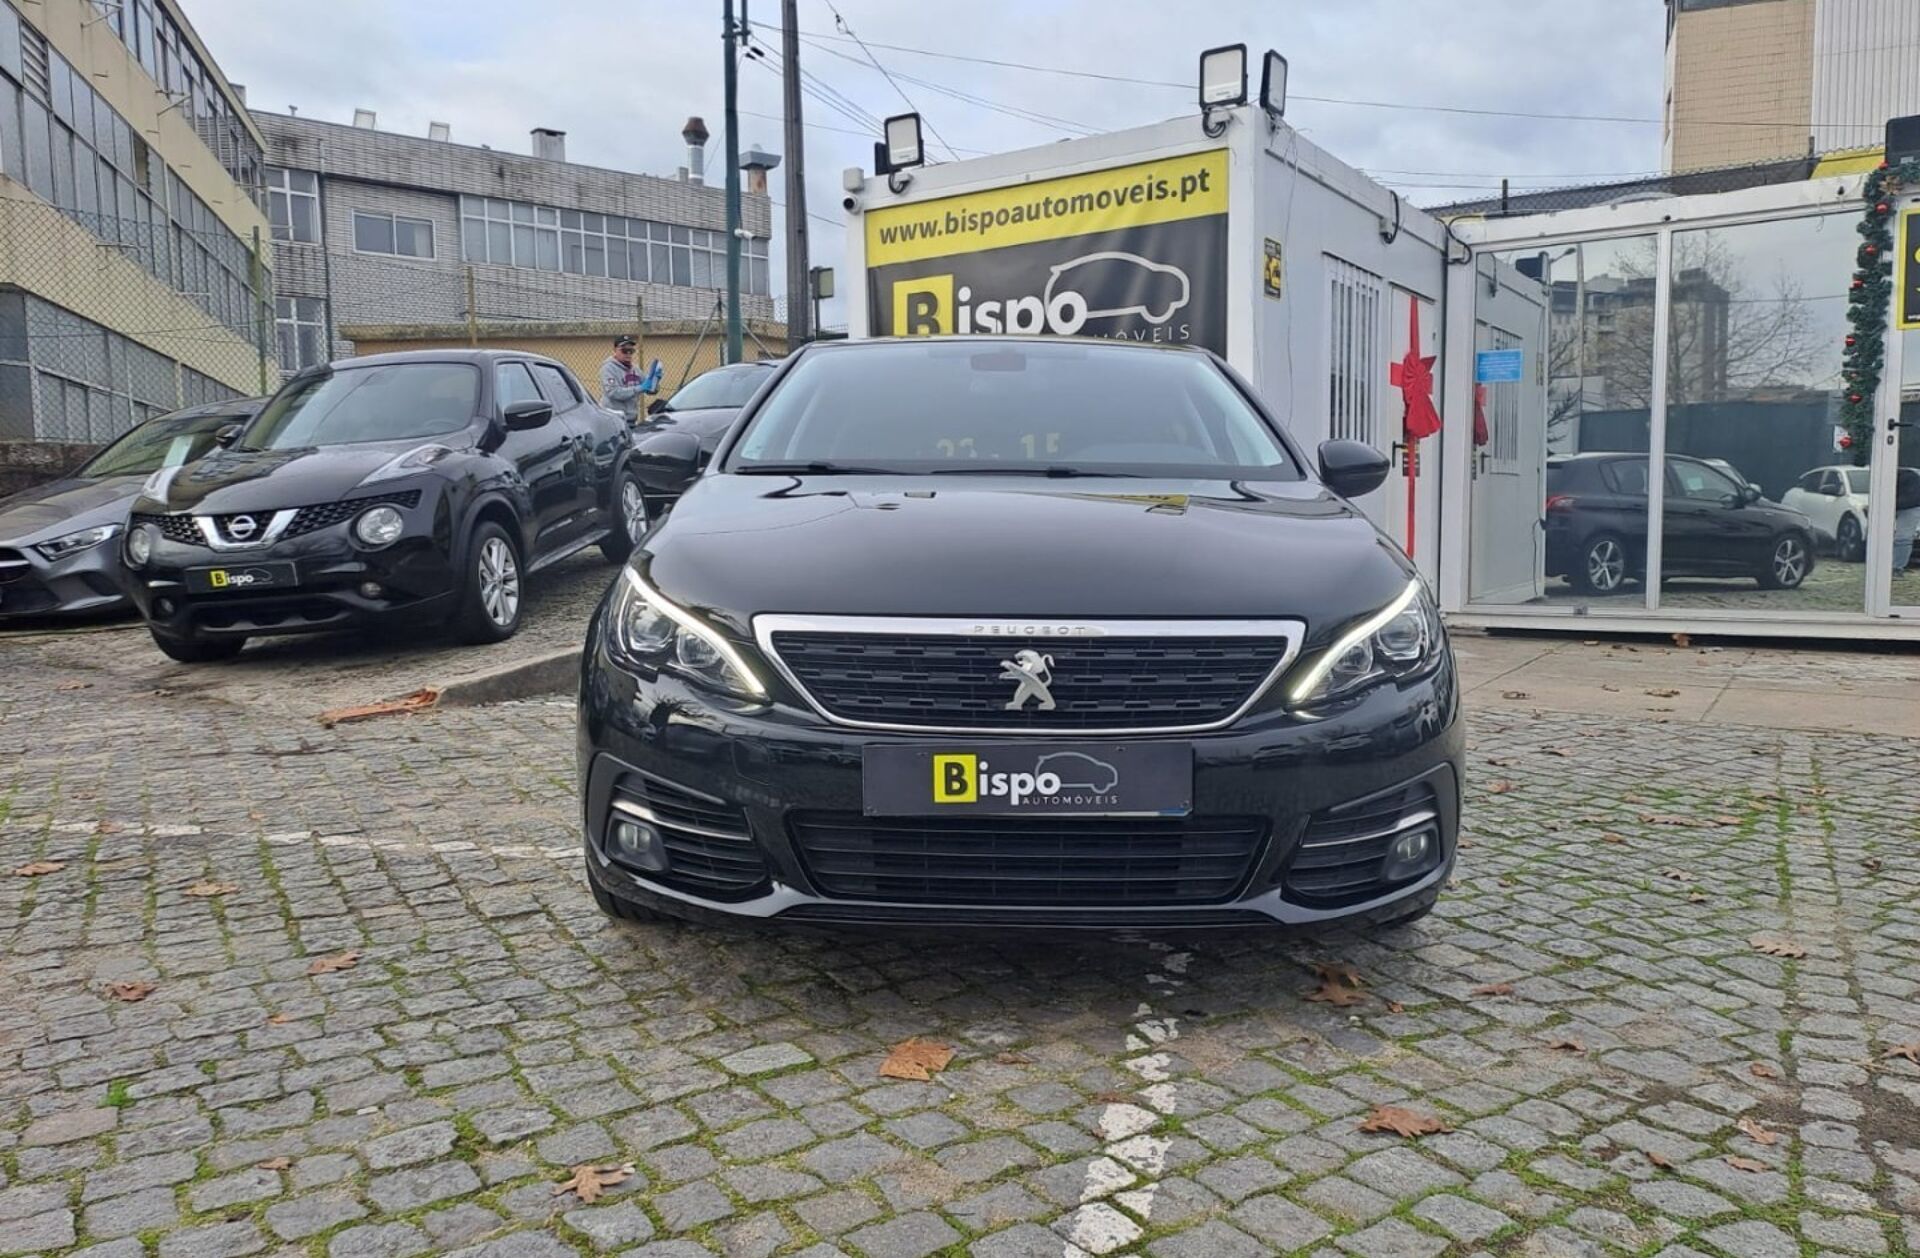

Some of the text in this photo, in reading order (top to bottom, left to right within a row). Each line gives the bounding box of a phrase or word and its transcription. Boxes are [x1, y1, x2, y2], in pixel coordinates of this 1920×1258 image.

[879, 167, 1211, 245] www.bispoautomoveis.pt
[213, 571, 255, 587] Bispo
[973, 625, 1086, 636] PEUGEOT
[943, 760, 1062, 806] Bispo
[1022, 793, 1119, 806] AUTOMÓVEIS
